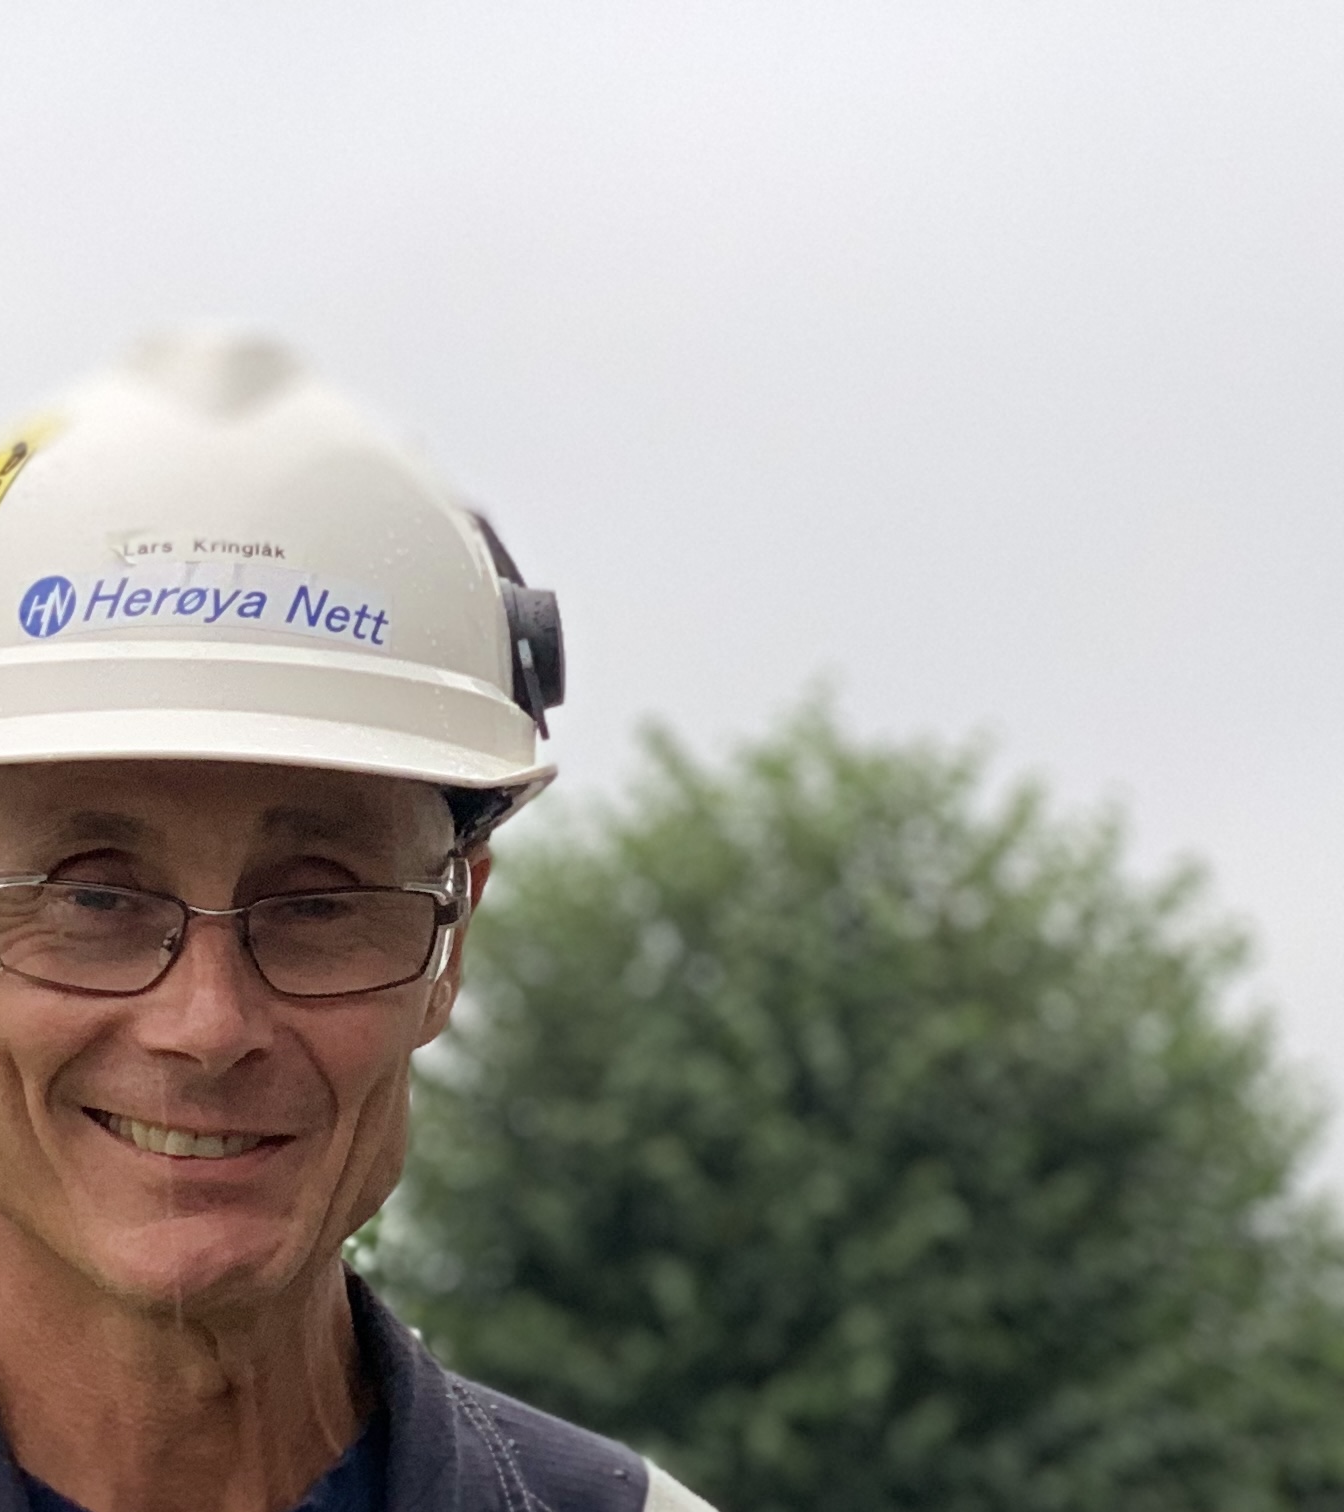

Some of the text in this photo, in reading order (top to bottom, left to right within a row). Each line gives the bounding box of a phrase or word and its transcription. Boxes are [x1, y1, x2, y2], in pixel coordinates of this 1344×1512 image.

[123, 541, 173, 556] Lars
[83, 576, 267, 624] Herøya
[286, 584, 390, 646] Nett
